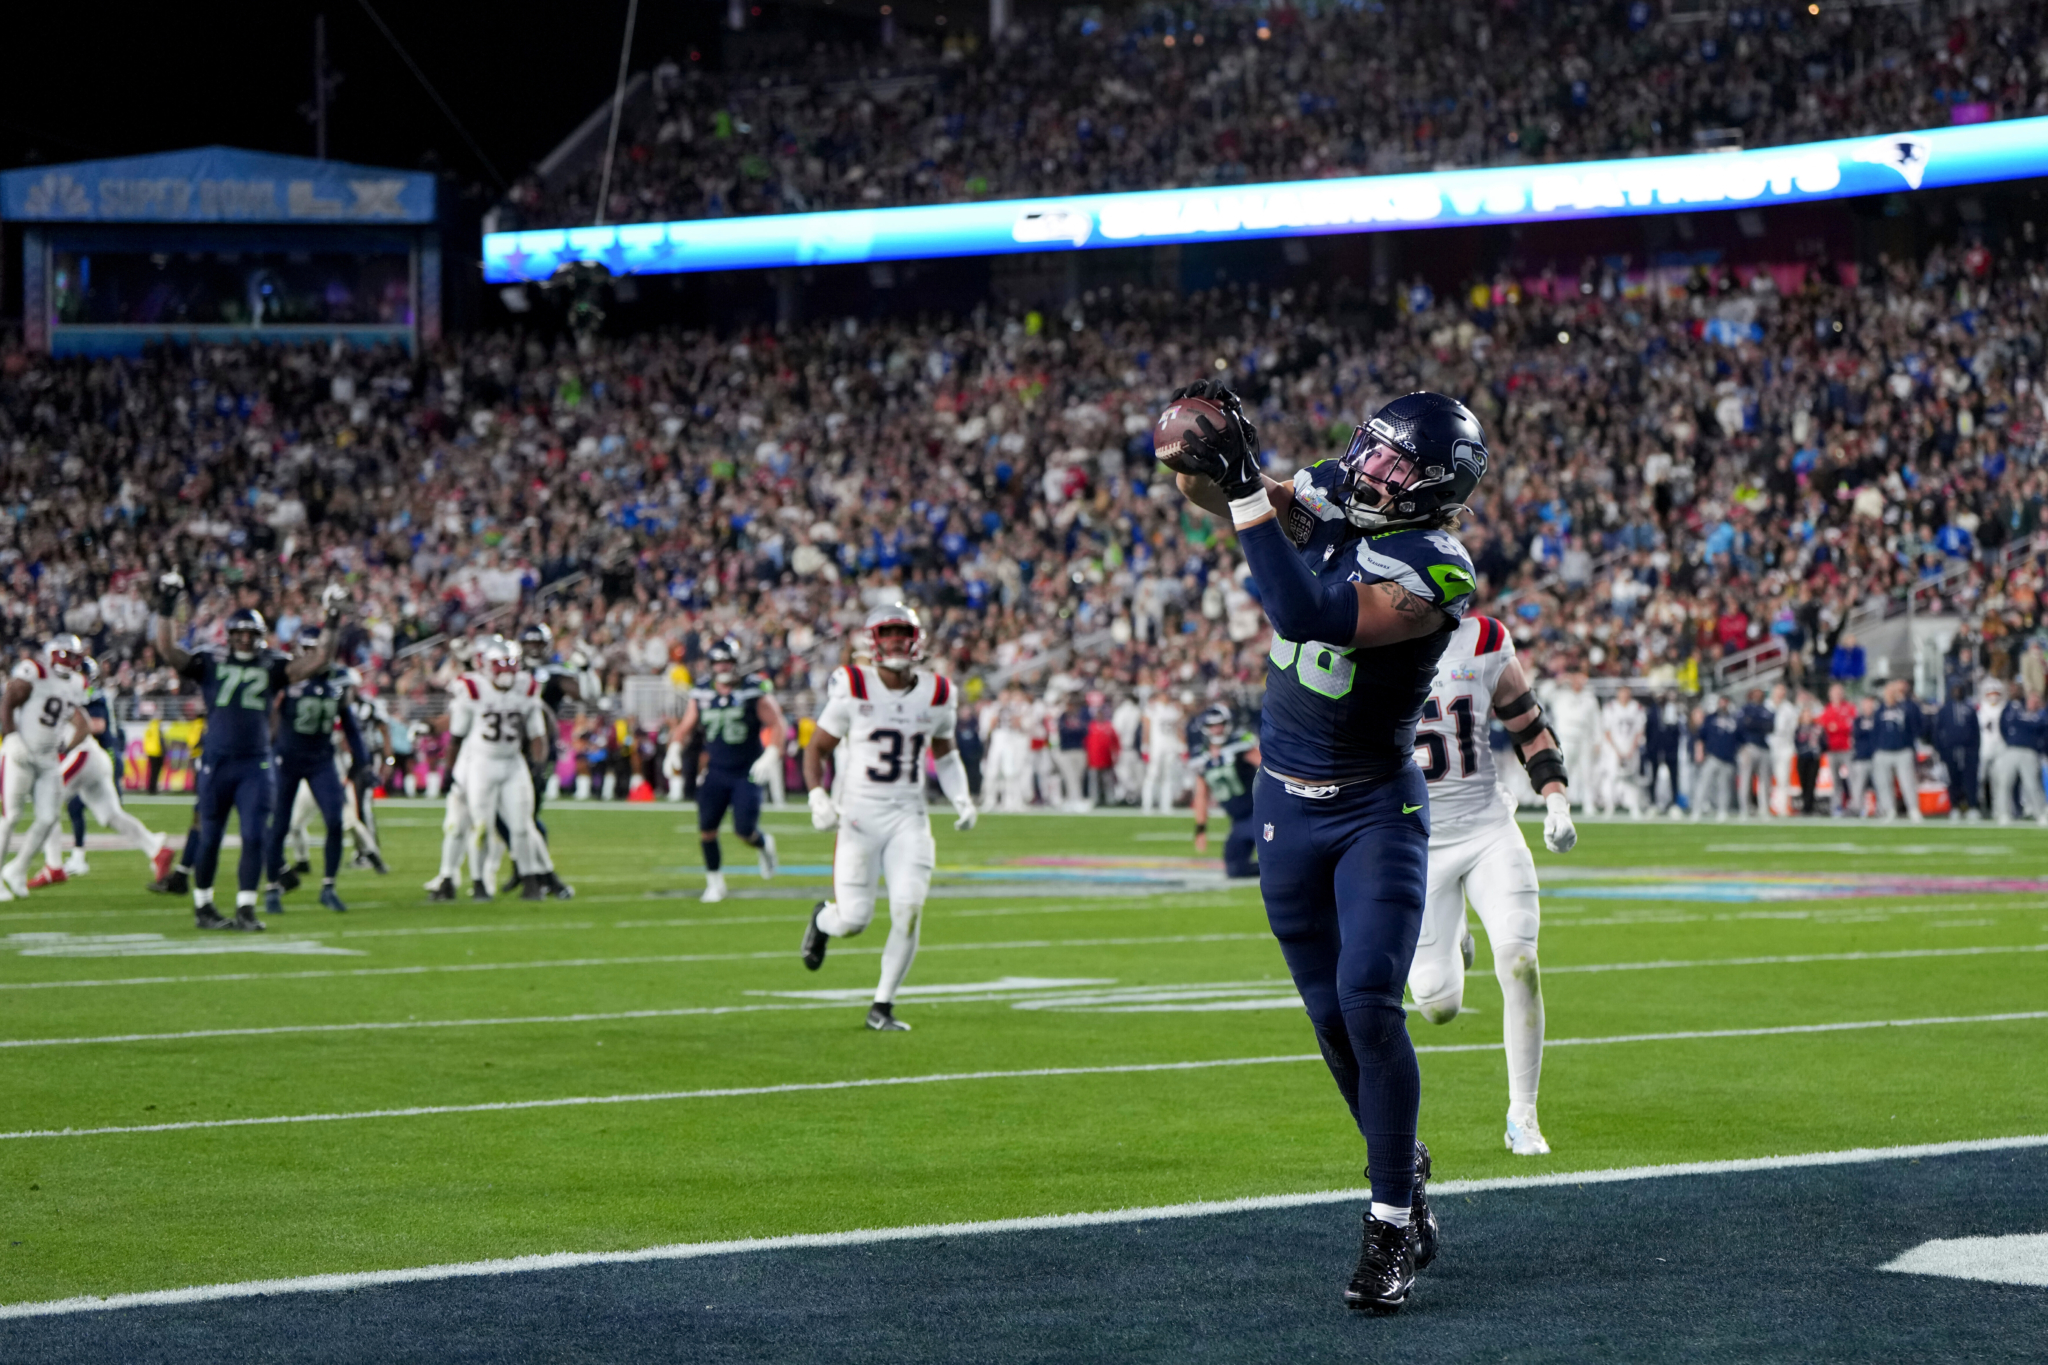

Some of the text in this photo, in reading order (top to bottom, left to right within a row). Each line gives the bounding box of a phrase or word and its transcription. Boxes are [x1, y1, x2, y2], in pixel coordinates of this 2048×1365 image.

[98, 178, 407, 217] SUPER BOWL LX
[1531, 152, 1841, 213] PATRIOTS
[1292, 511, 1311, 529] USA
[215, 663, 270, 711] 72
[482, 711, 525, 742] 33
[866, 727, 926, 784] 31
